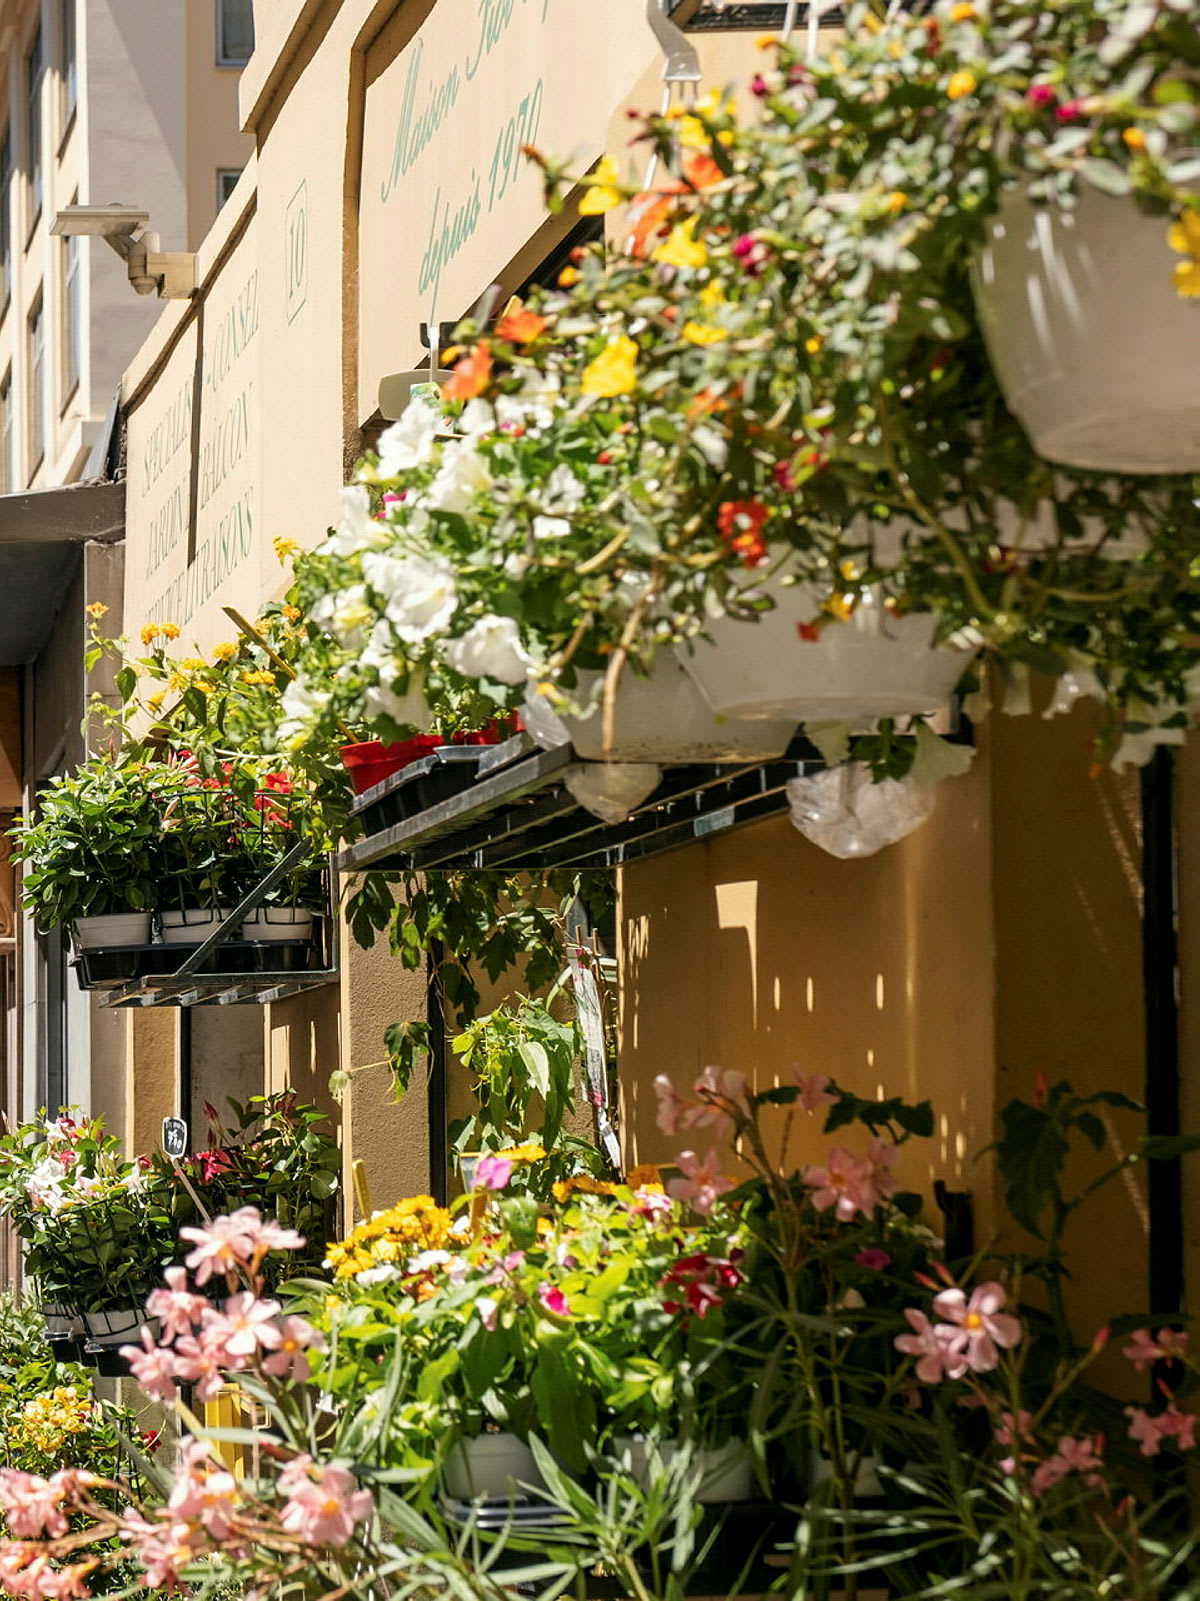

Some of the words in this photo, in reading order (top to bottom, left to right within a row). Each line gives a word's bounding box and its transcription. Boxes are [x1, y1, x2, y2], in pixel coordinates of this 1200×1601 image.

[381, 36, 460, 204] Maison
[419, 167, 481, 328] depuis
[488, 77, 542, 213] 1970
[288, 207, 305, 300] 10
